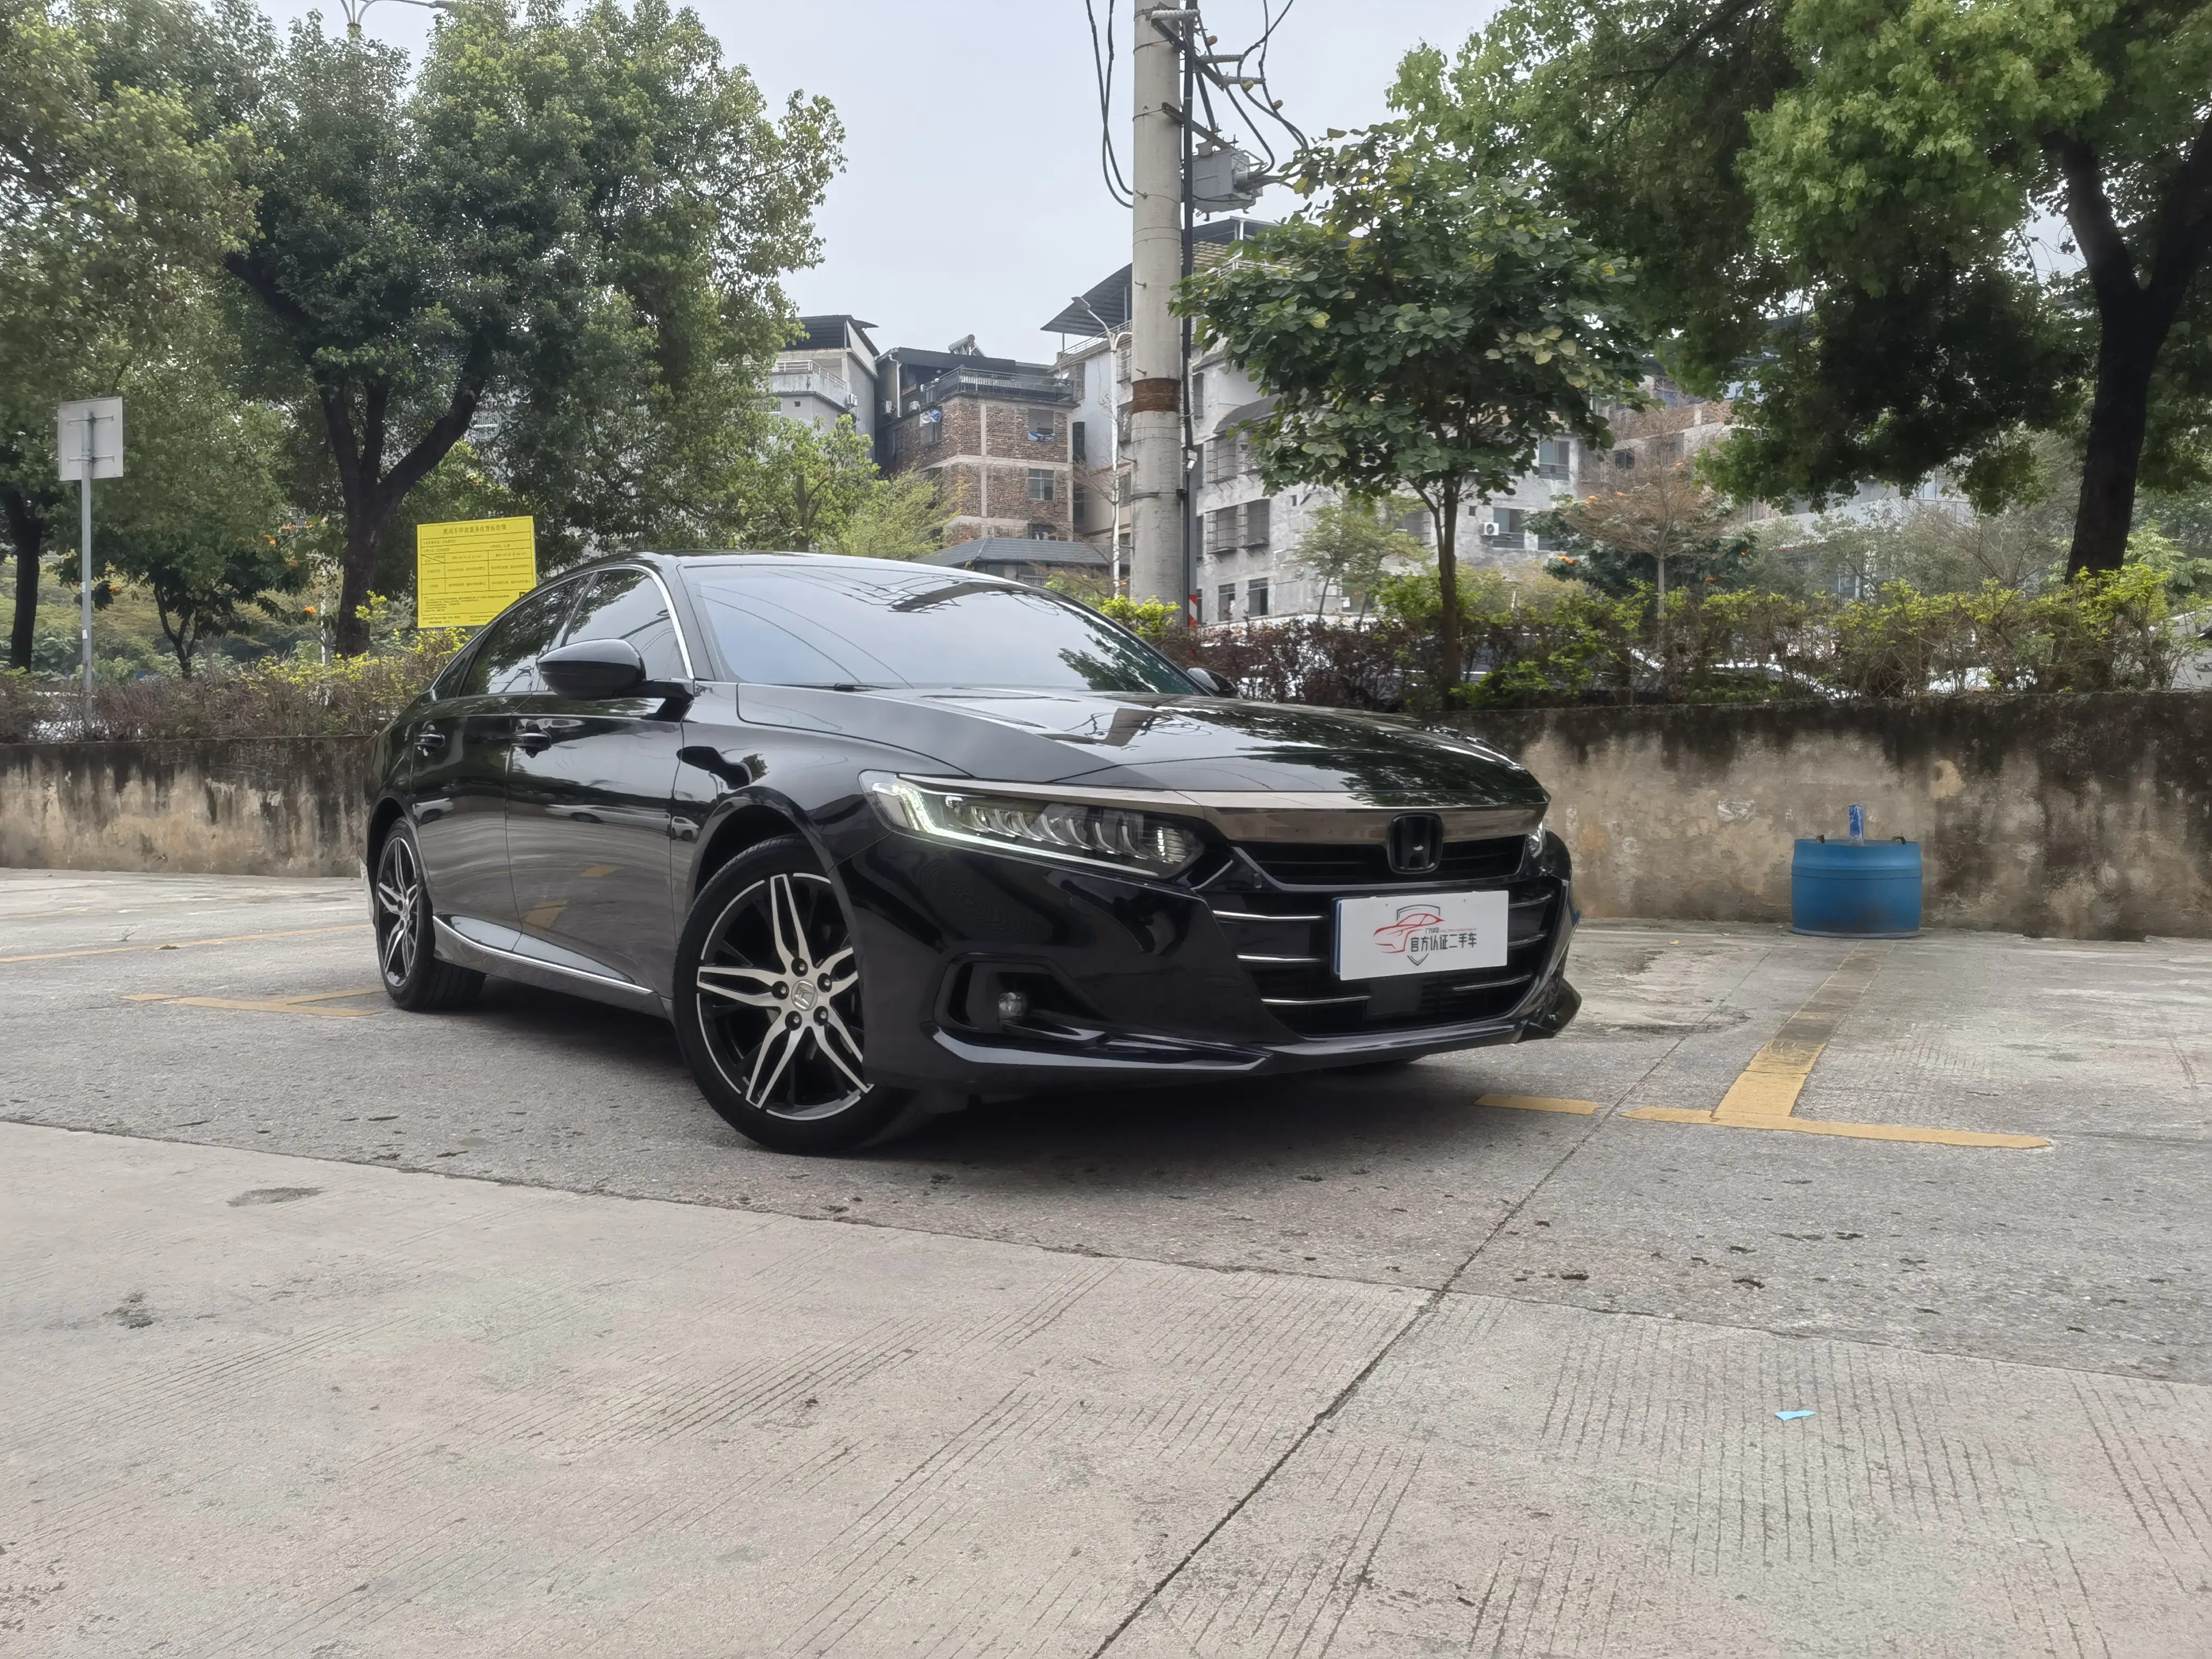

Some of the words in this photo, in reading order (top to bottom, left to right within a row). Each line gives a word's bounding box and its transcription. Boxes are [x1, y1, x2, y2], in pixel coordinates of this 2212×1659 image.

[1410, 932, 1477, 952] 官方认证二手车
